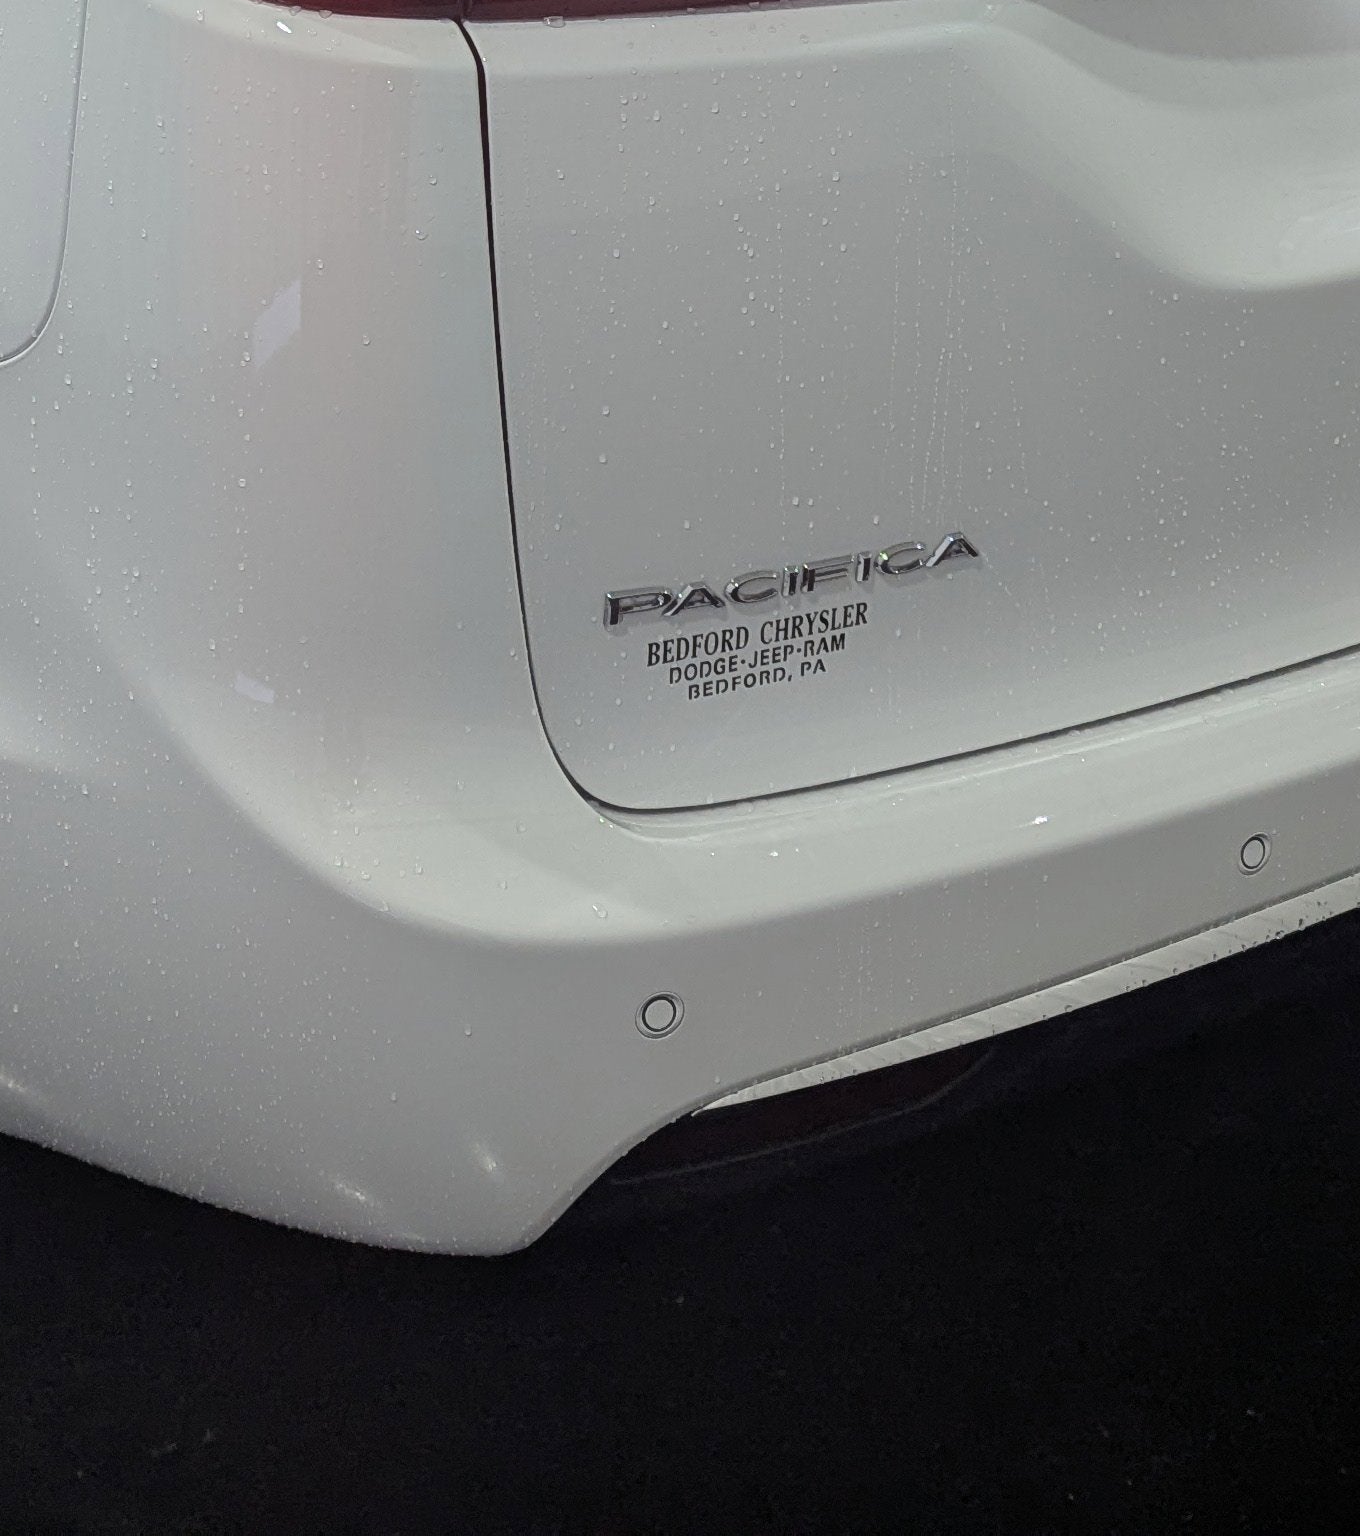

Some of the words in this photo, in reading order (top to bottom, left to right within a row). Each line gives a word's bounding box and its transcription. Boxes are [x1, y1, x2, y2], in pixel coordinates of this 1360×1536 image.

[603, 531, 981, 628] PACIFICA
[646, 625, 750, 667] BEDFORD
[760, 602, 869, 646] CHRYSLER
[688, 665, 793, 700] BEDFORD,
[800, 659, 827, 676] PA
